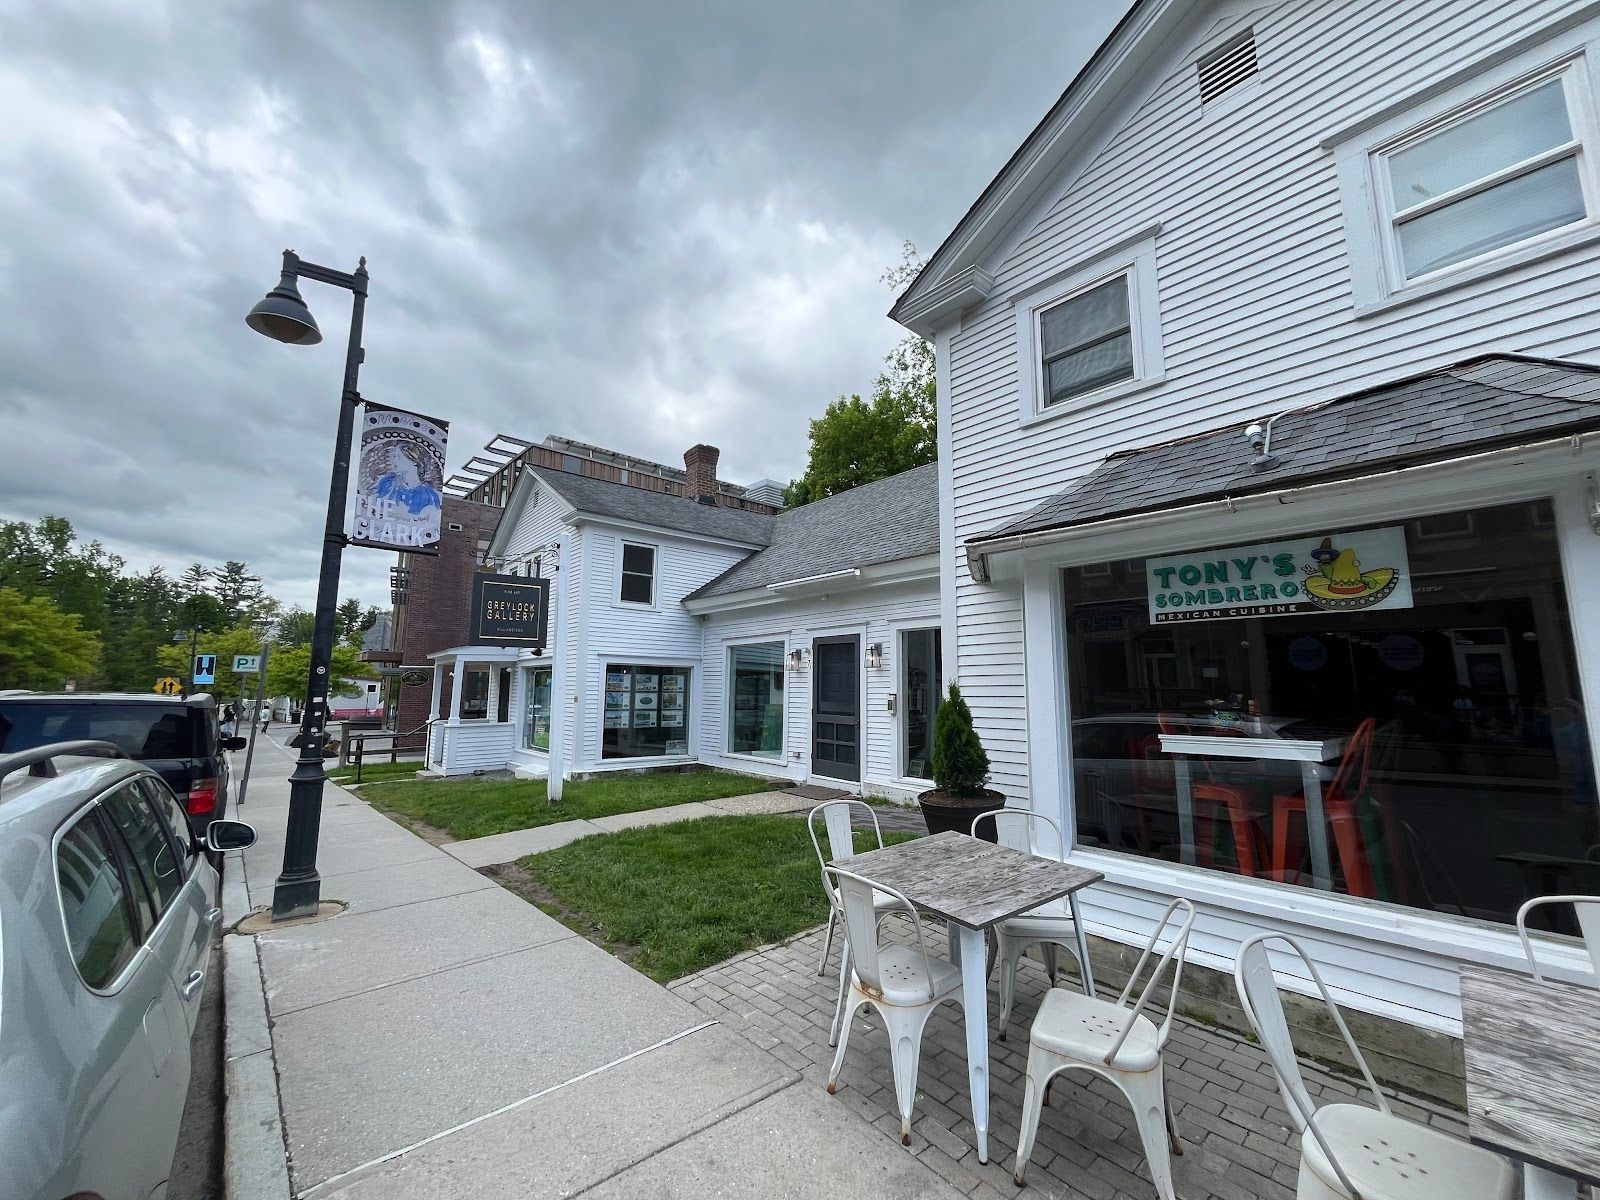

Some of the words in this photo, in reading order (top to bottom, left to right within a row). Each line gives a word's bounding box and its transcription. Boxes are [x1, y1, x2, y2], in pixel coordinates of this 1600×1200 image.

[353, 516, 424, 548] CLARK
[1153, 552, 1297, 589] TONY'S
[1155, 581, 1300, 608] SOMBRERO
[487, 600, 535, 612] GREYLOCK
[1157, 610, 1221, 621] MEXICAN
[1229, 604, 1297, 616] CUISINE
[486, 609, 535, 622] GALLERY
[236, 658, 249, 669] P
